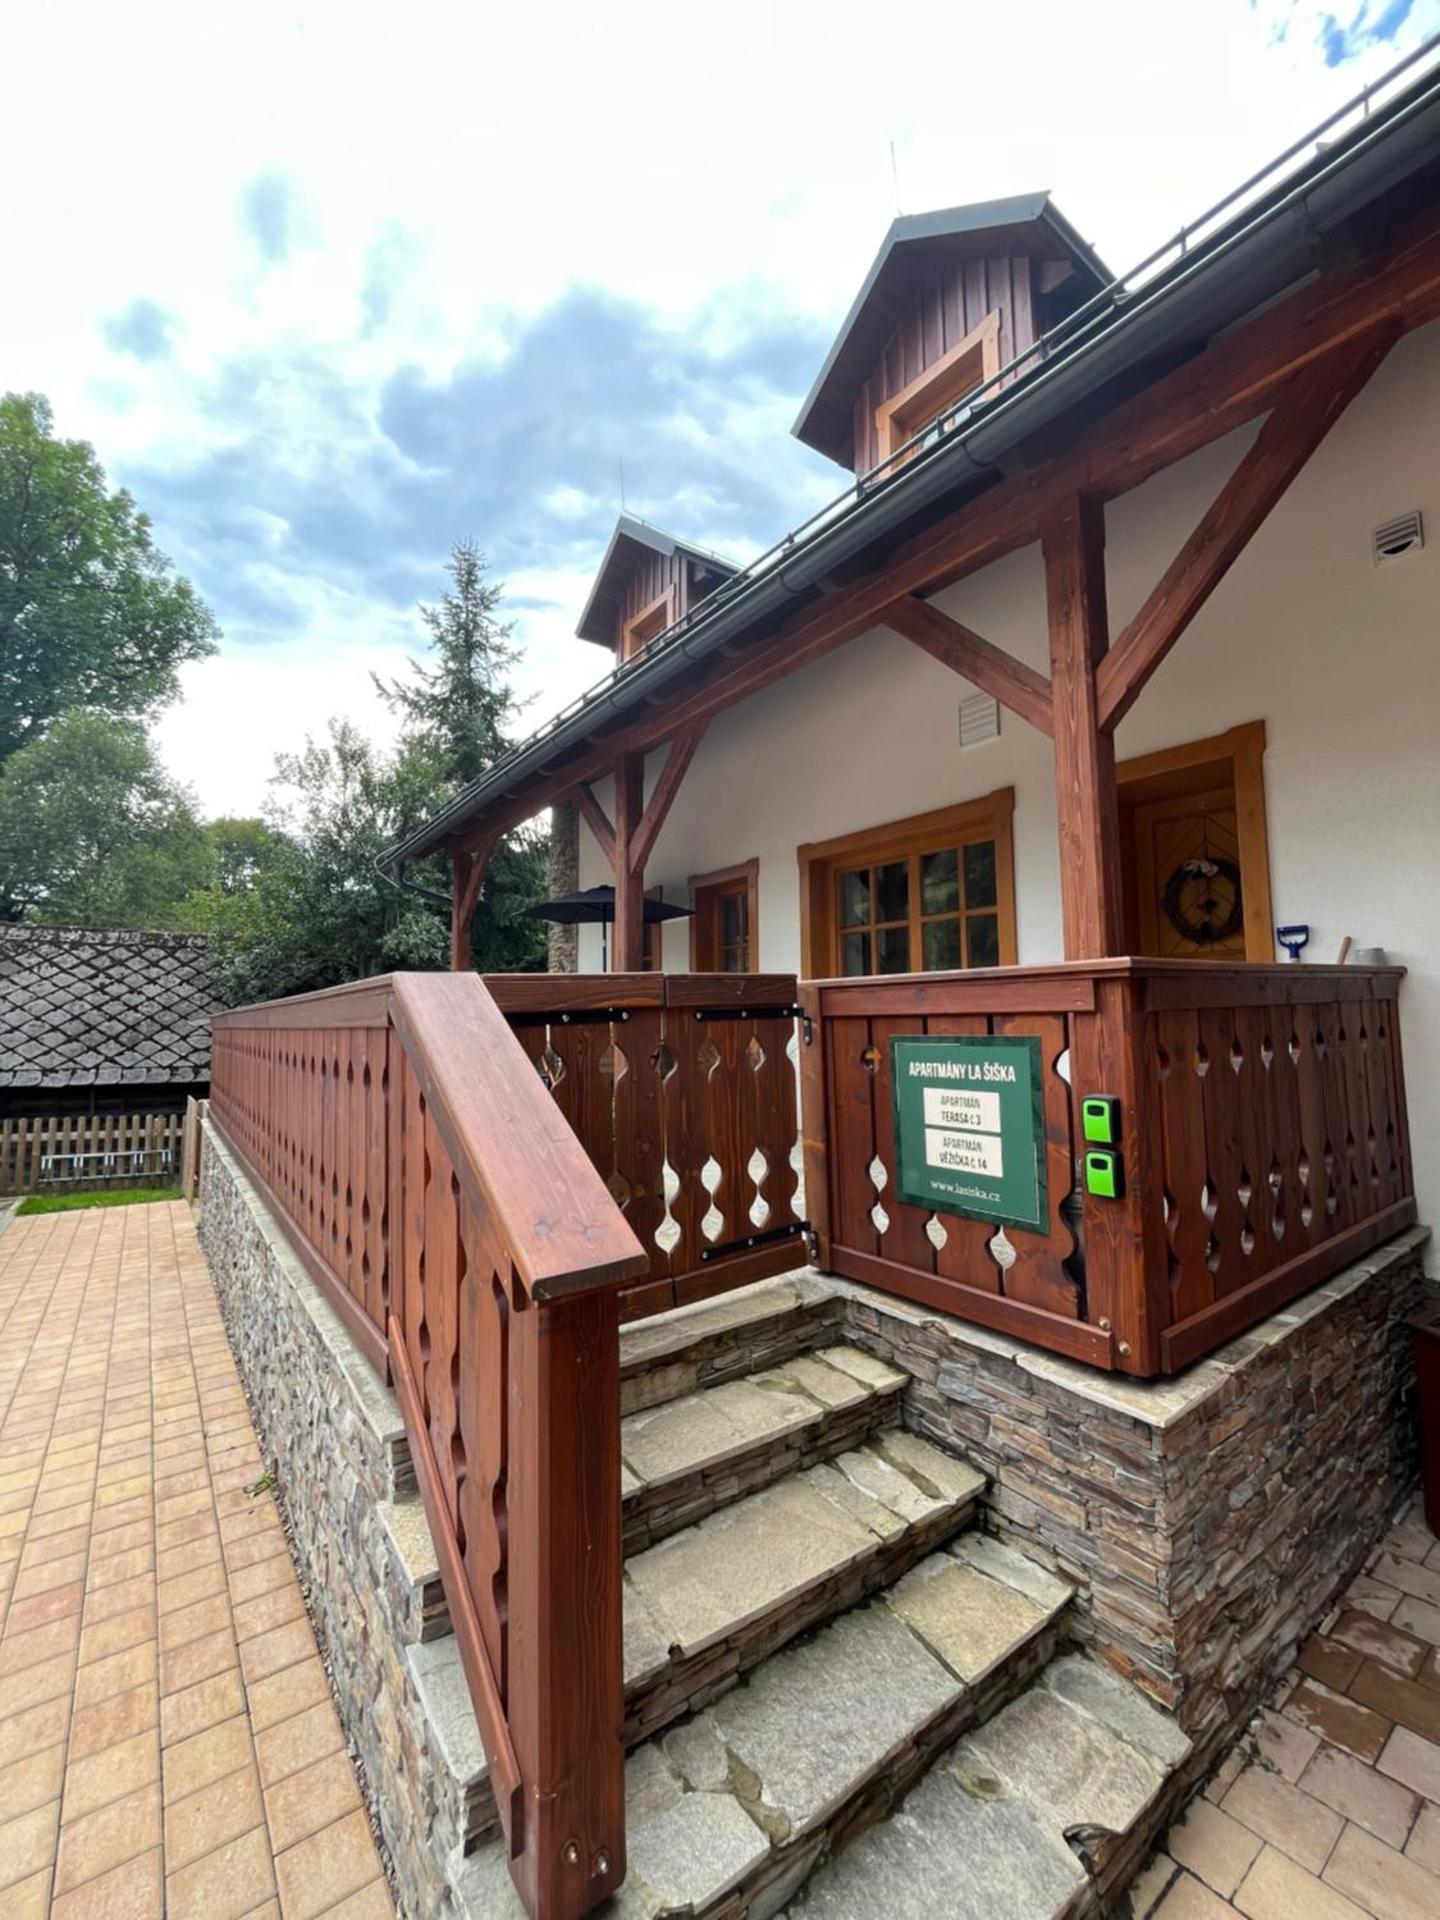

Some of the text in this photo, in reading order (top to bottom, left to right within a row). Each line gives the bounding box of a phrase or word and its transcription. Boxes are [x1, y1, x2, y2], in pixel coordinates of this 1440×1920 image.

[909, 1060, 1016, 1082] APARTMÁNY LA ŠIŠKA
[941, 1110, 970, 1124] TERASA
